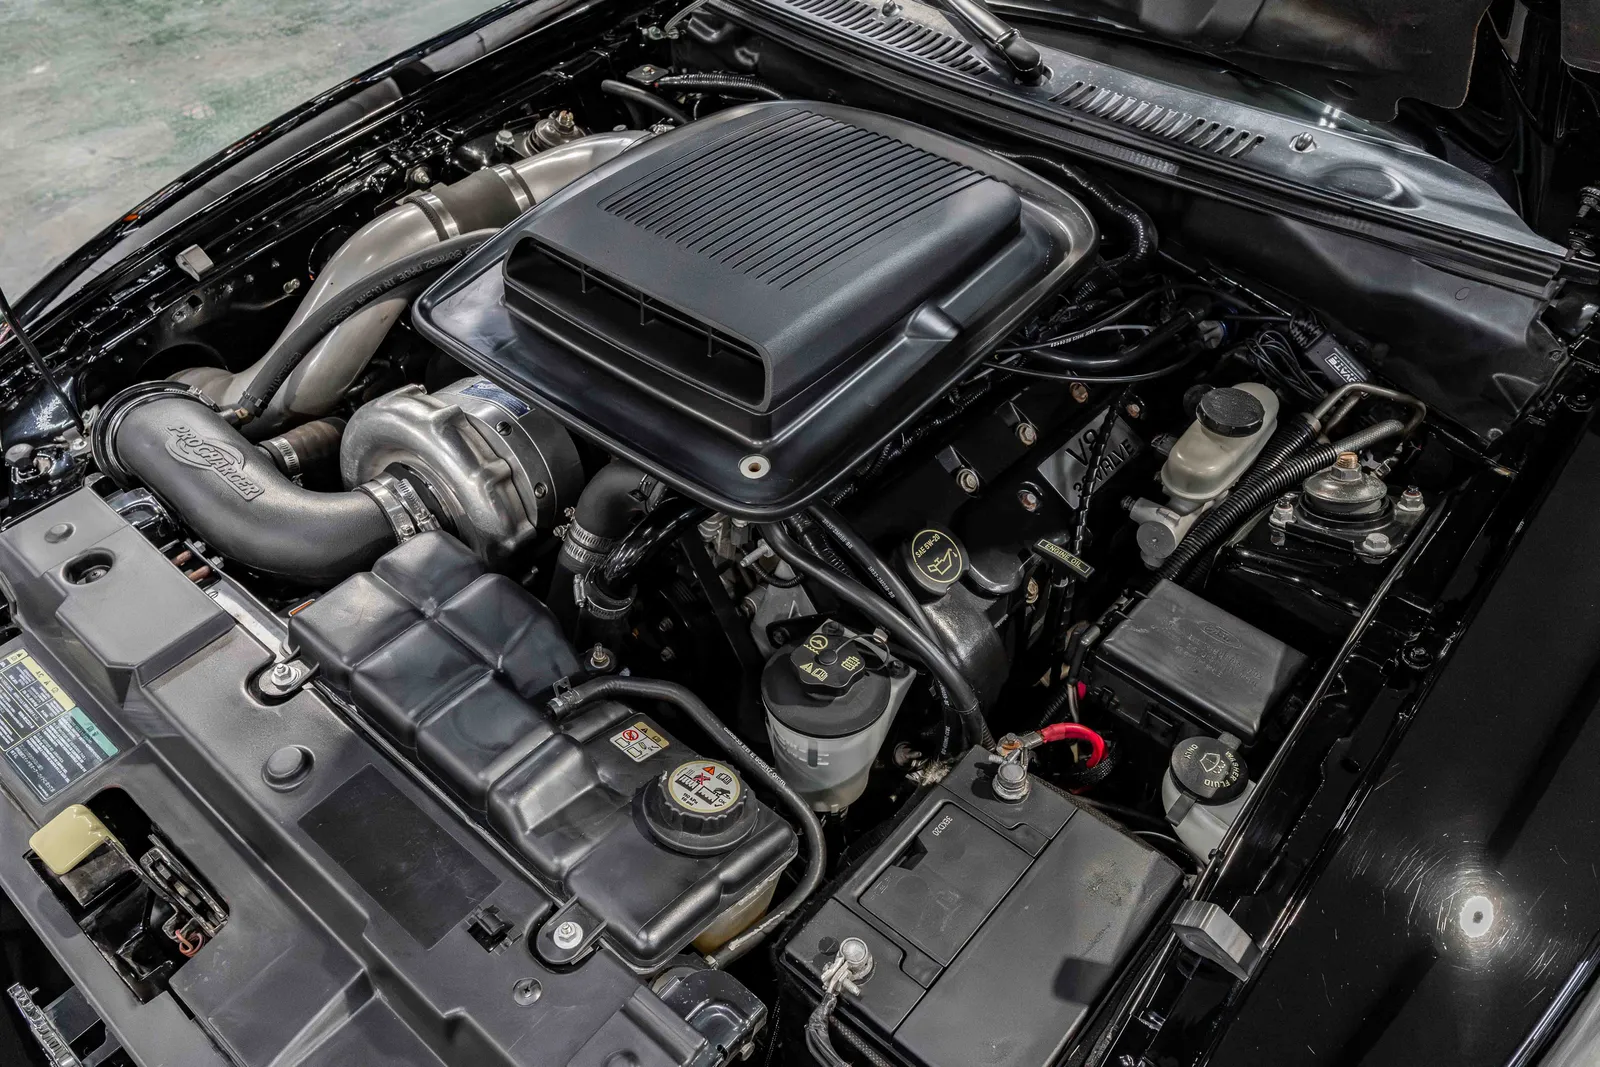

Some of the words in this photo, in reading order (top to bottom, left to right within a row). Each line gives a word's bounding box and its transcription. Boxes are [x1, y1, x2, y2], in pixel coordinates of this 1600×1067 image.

[399, 263, 424, 282] MADE
[164, 424, 262, 497] PROCHARGER
[914, 547, 927, 558] SAE
[924, 533, 941, 551] 5W-20
[1044, 542, 1070, 561] ENGINE
[1070, 557, 1083, 569] OIL
[1184, 743, 1199, 760] ONLY
[1204, 778, 1231, 788] FLUID
[931, 815, 954, 837] 3EKD20
